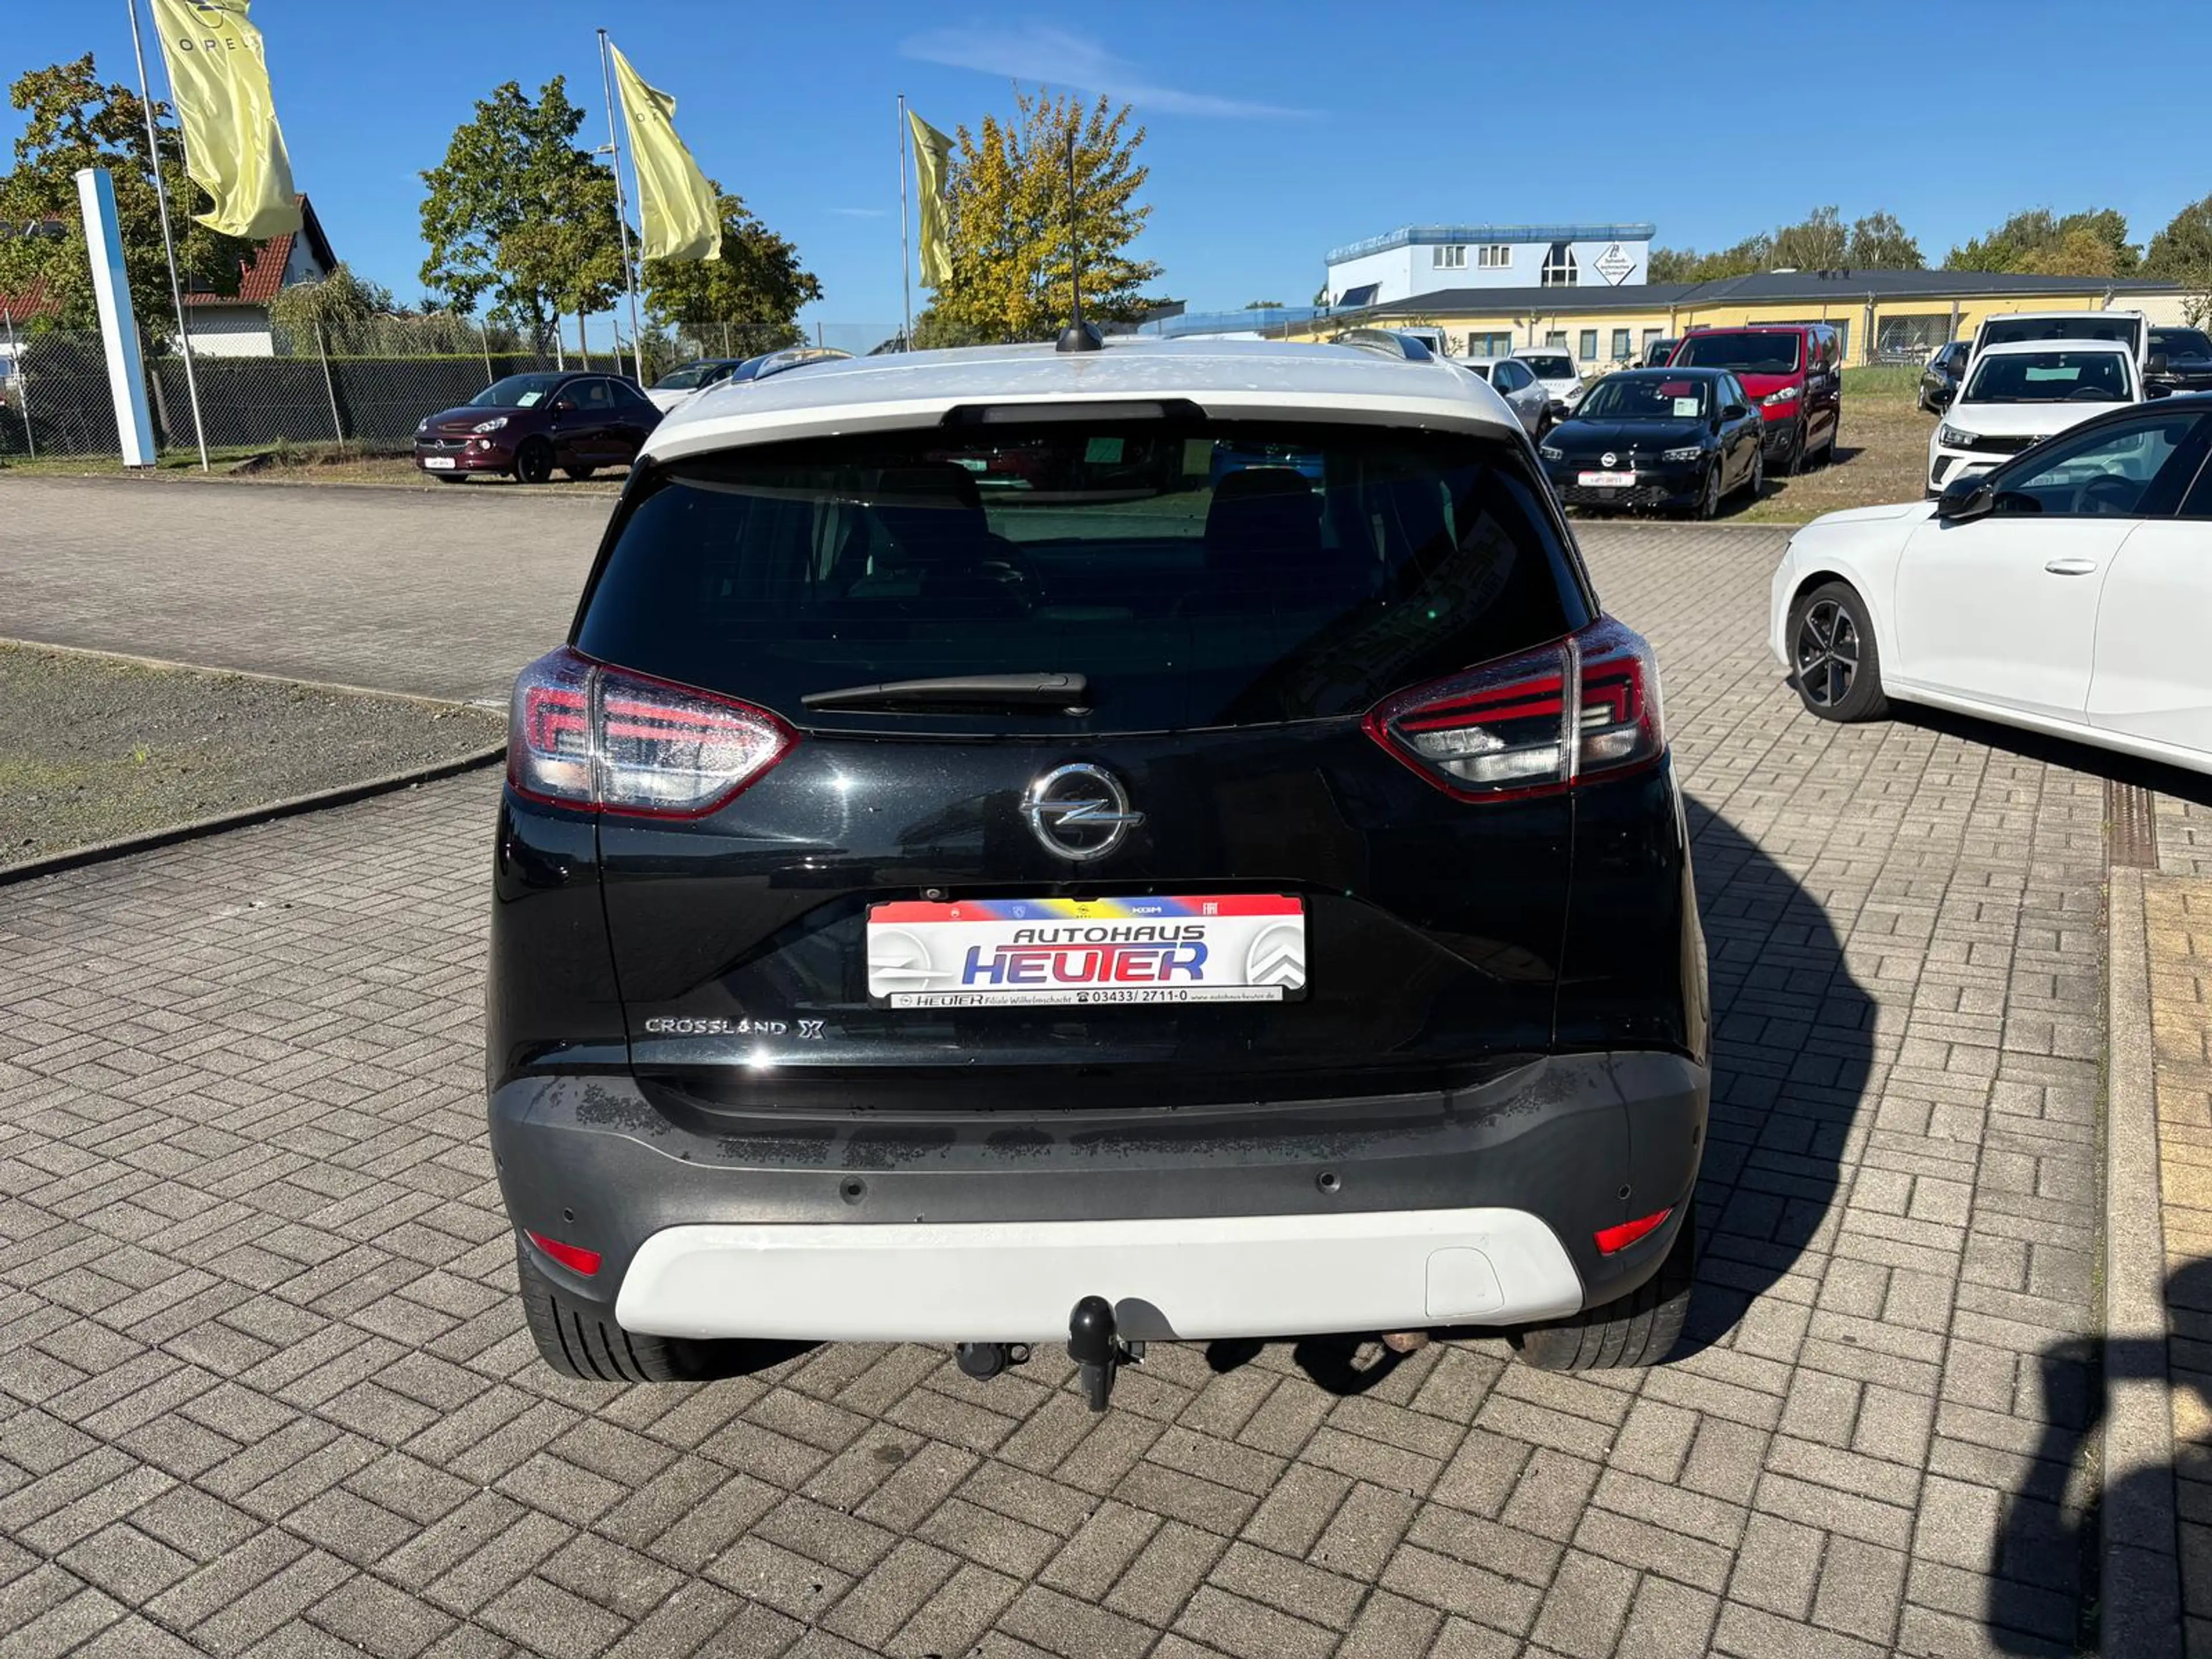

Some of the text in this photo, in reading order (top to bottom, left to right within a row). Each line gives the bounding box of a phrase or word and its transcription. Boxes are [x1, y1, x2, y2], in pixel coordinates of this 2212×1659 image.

[1013, 925, 1205, 944] AUTOHAUS
[961, 941, 1209, 984] HEUTER
[916, 994, 983, 1006] HEUTER
[1092, 990, 1139, 1002] 03433/
[1142, 990, 1187, 1002] 2711-0
[645, 1017, 827, 1039] CROSSLAND X
